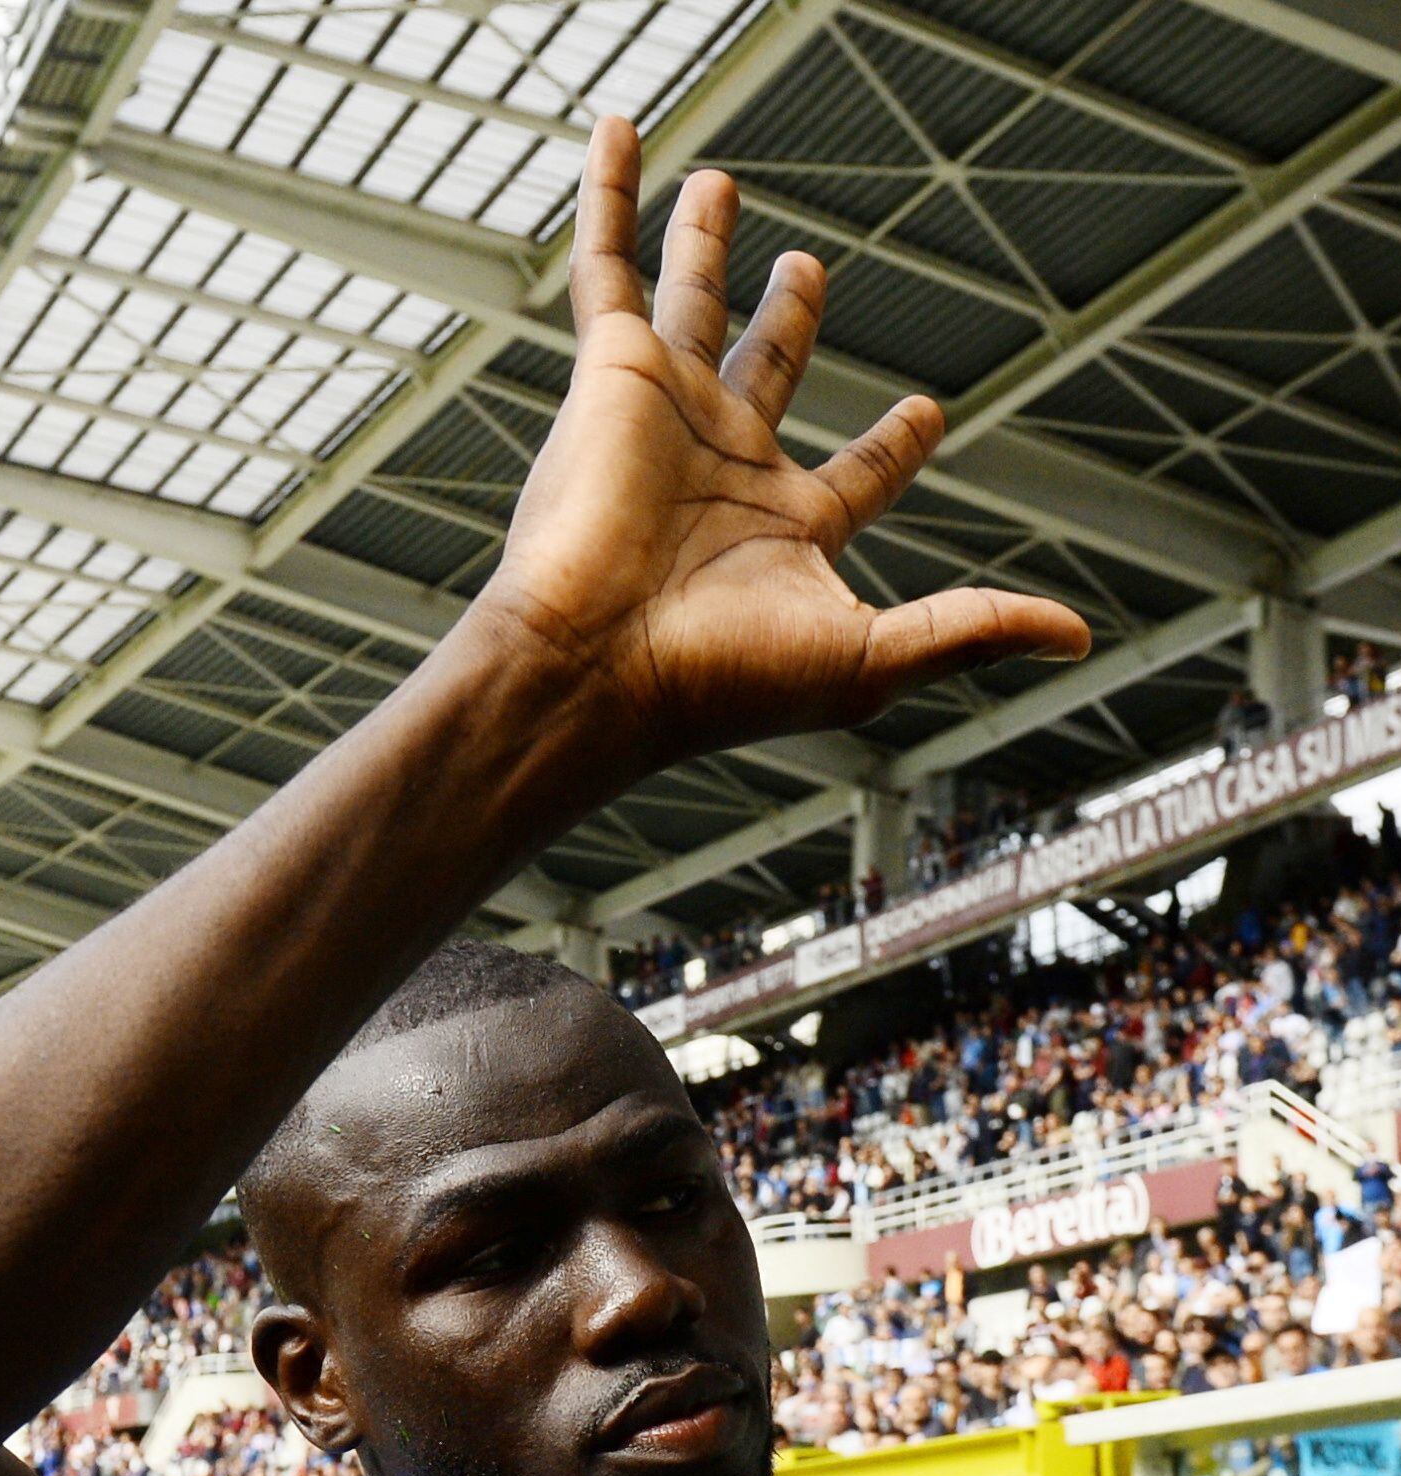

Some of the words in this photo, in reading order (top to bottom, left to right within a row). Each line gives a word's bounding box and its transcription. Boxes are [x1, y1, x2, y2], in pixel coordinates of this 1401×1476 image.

[1018, 816, 1123, 898] ARREDA
[1121, 803, 1159, 857] LA
[1155, 781, 1218, 842] TUA
[1216, 743, 1298, 819] CASA
[1296, 721, 1343, 787] SU
